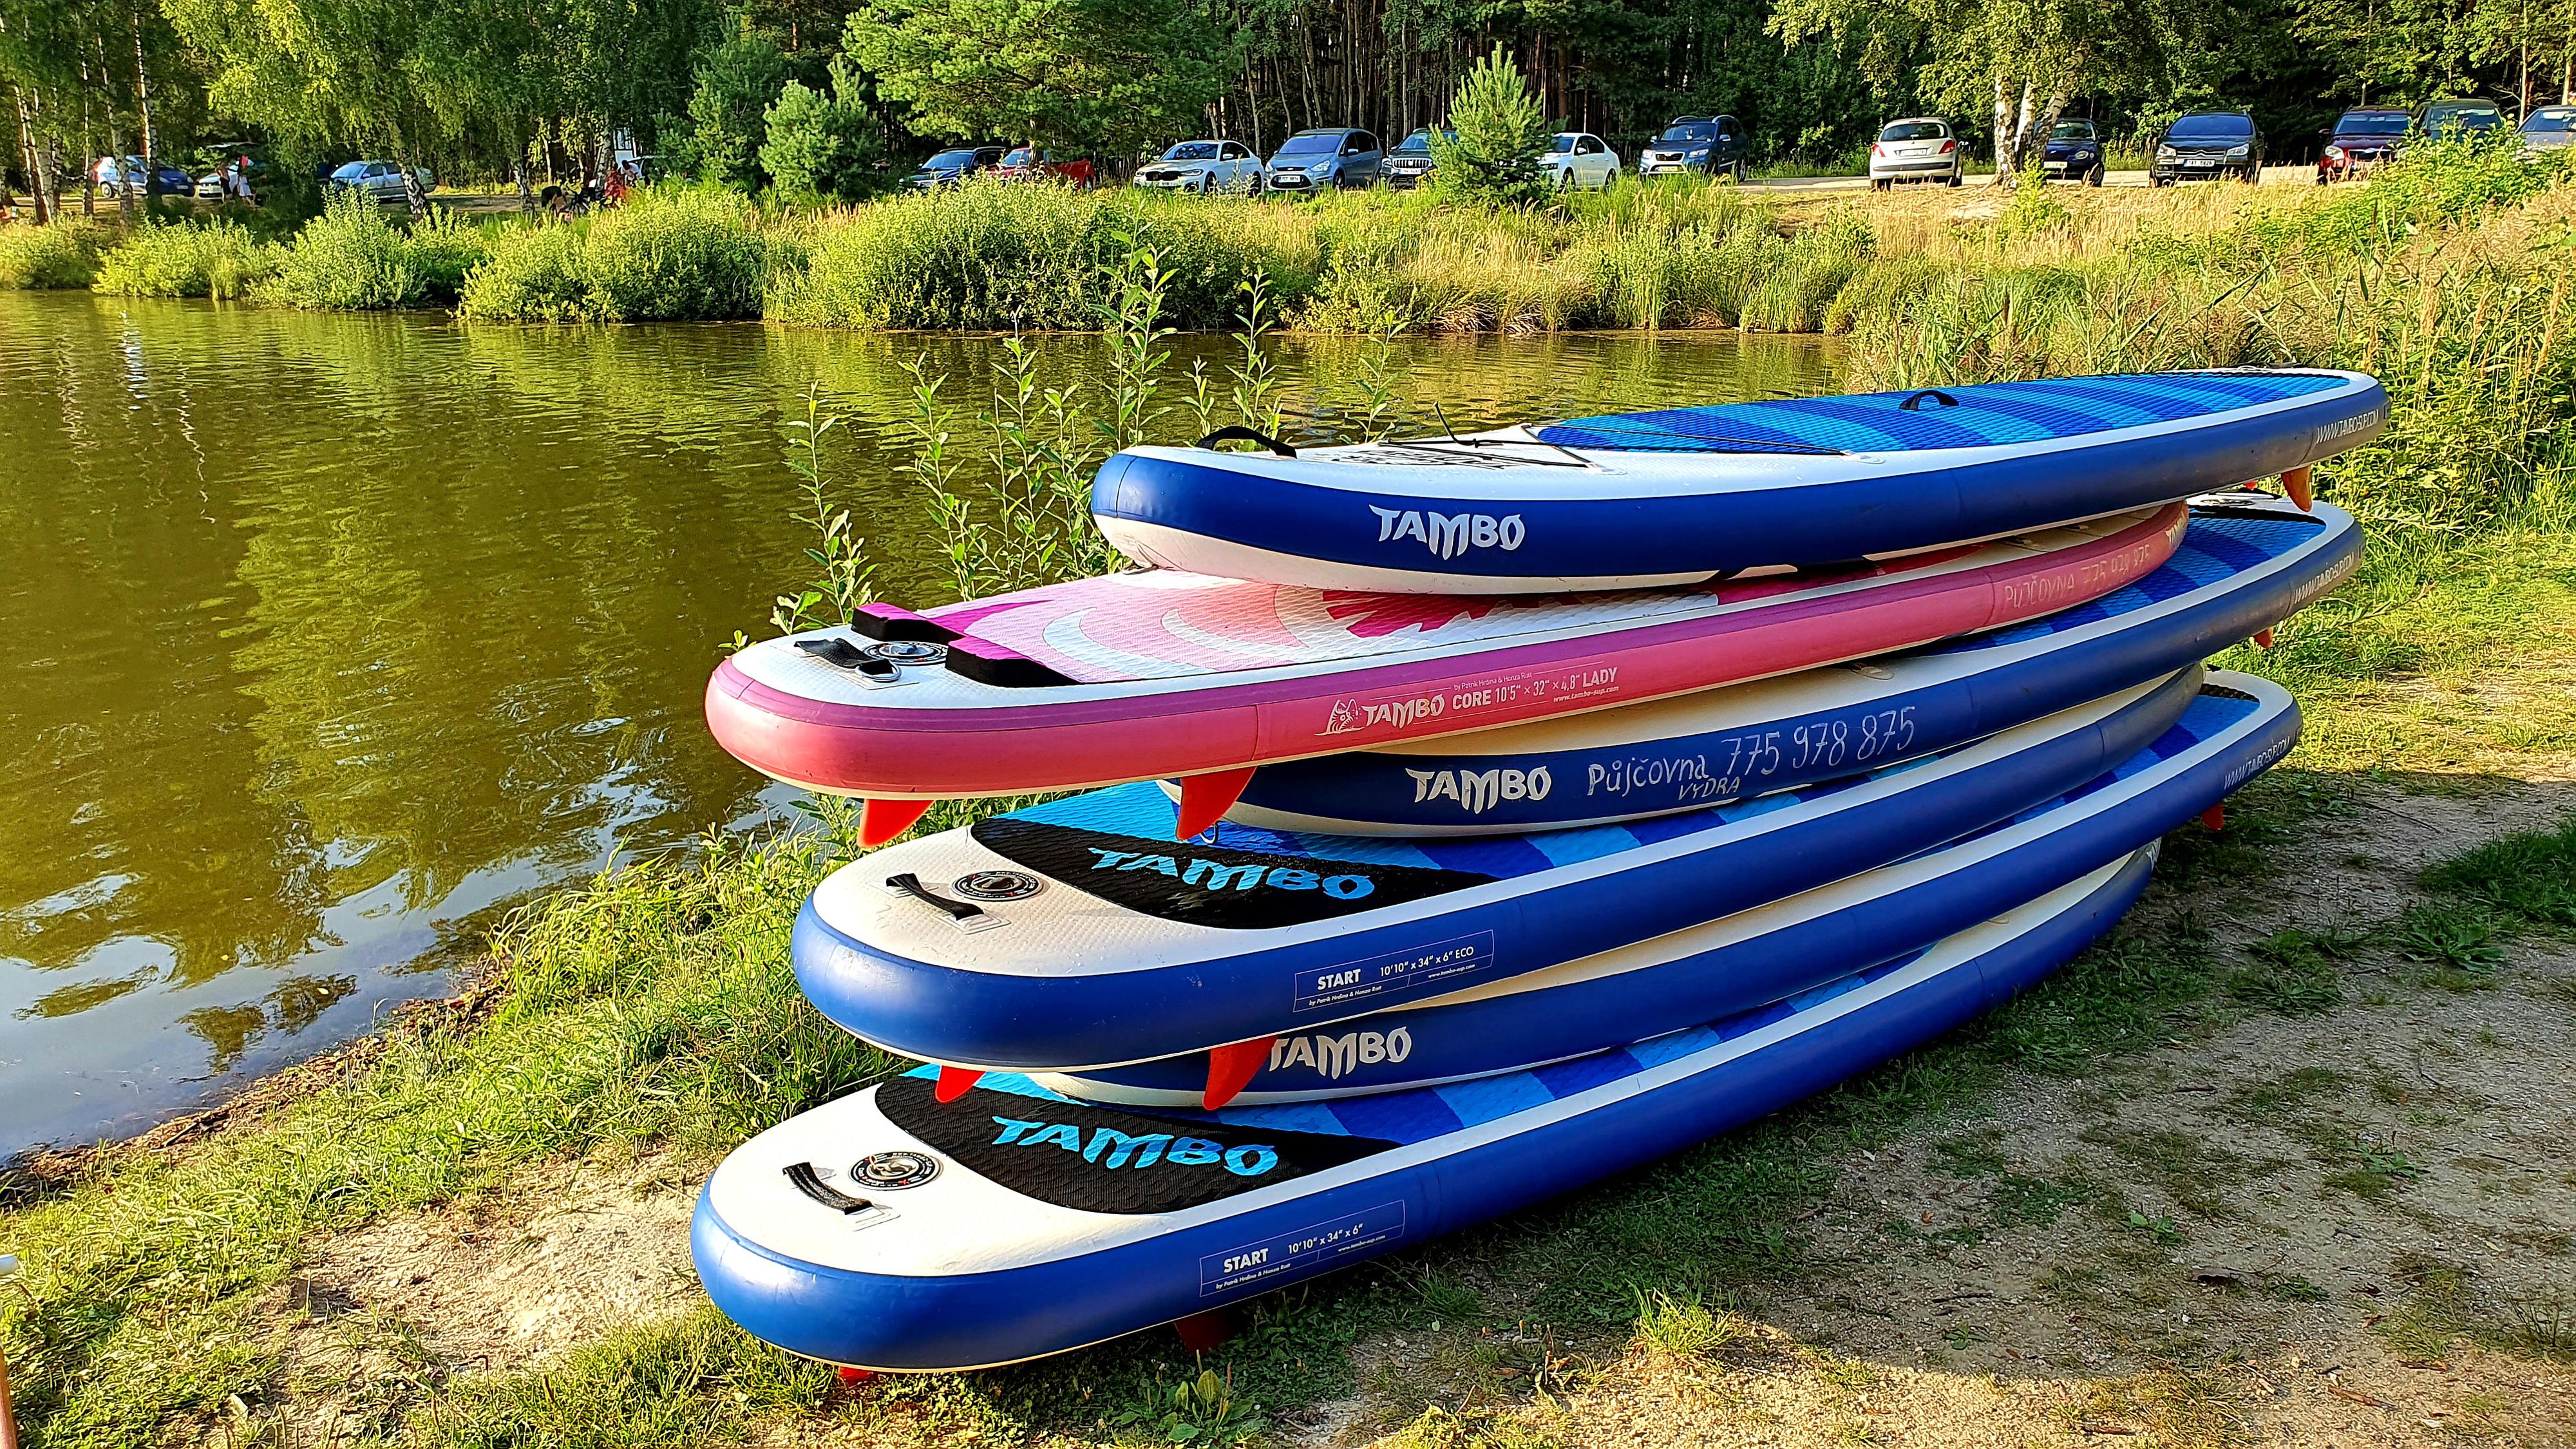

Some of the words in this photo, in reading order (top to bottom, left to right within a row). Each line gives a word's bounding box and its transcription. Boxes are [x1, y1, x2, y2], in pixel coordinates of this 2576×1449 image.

[1369, 504, 1526, 560] TAMBO
[1361, 694, 1445, 729] TAMBO
[1452, 689, 1492, 710] CORE
[1582, 667, 1618, 688] LADY
[1587, 753, 1709, 797] Půjčovna
[1721, 731, 1781, 775] 775
[1792, 720, 1847, 770] 978
[1857, 706, 1916, 761] 875
[1405, 766, 1552, 814] TAMBO
[1678, 775, 1741, 800] VYDRA
[1088, 848, 1375, 900] TAMBO
[1318, 968, 1361, 990] START
[1455, 946, 1474, 959] ECO
[1269, 1026, 1412, 1079] TAMBO
[992, 1116, 1278, 1176] TAMBO
[1224, 1247, 1269, 1273] START
